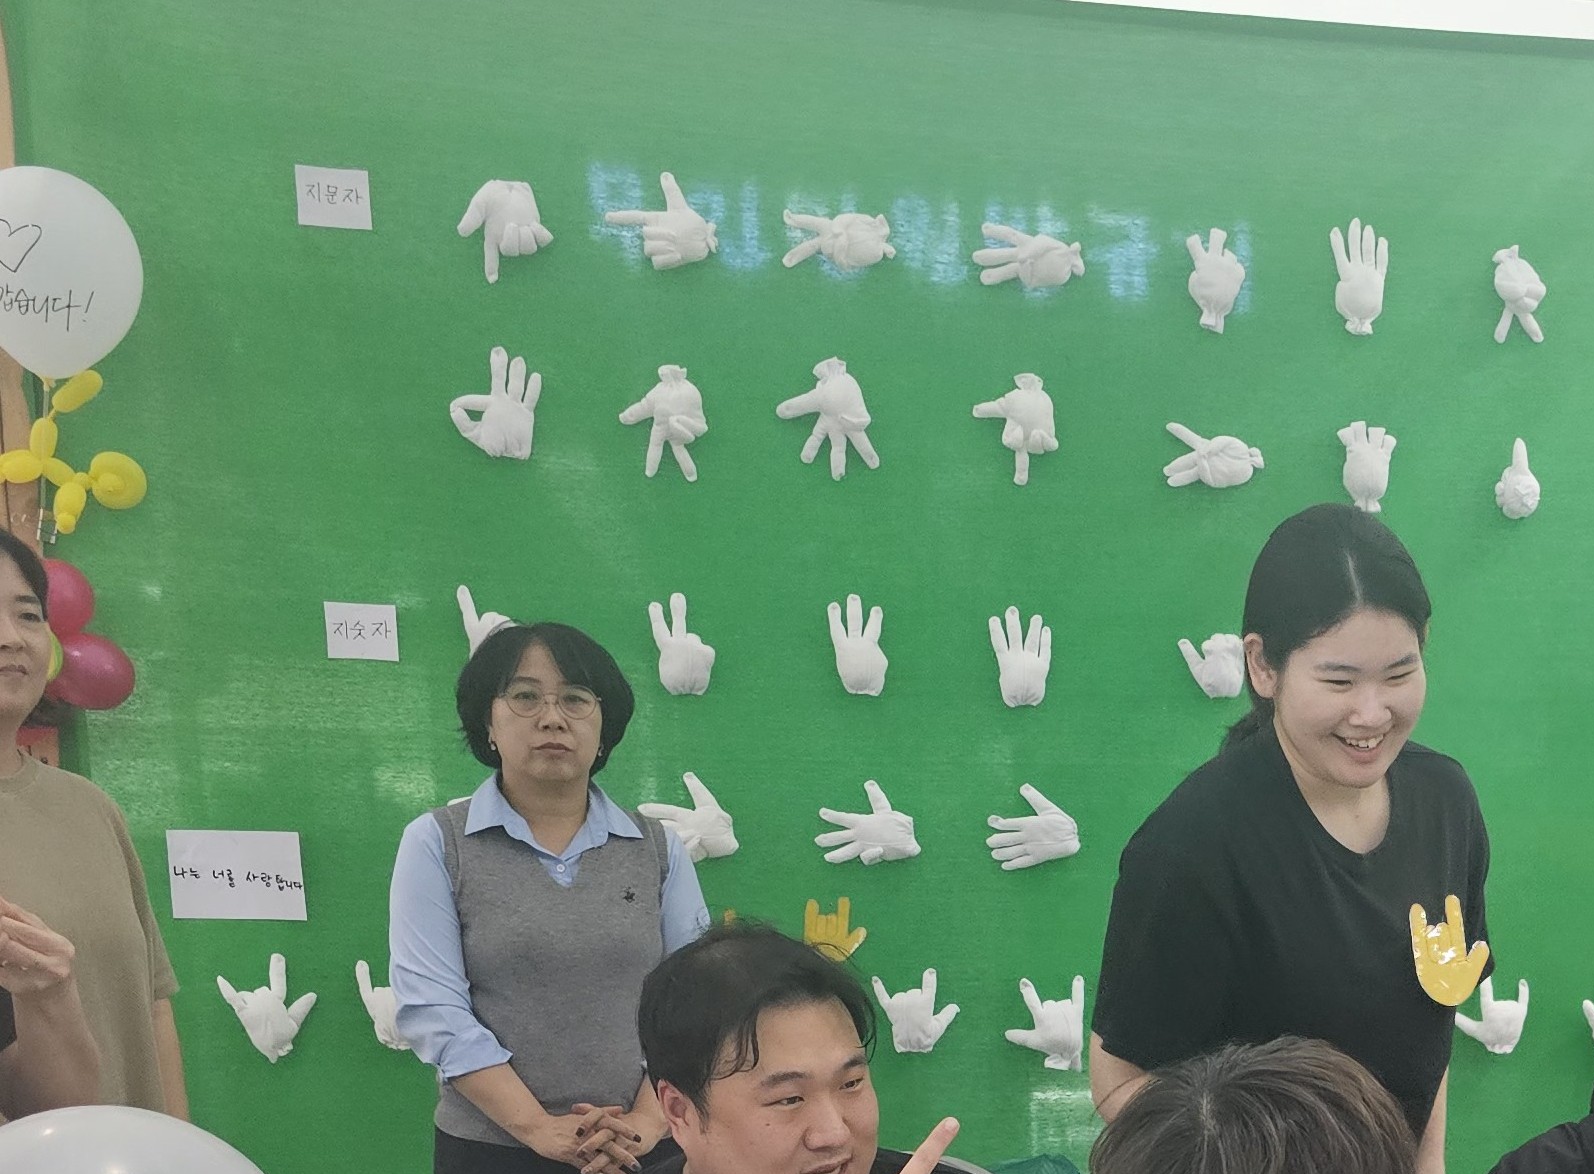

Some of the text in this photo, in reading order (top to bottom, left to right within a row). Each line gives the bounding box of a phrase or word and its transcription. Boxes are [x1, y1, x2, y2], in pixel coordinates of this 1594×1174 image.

[304, 181, 364, 205] 지문자
[332, 619, 392, 640] 지숫자
[173, 865, 200, 880] 나는
[212, 868, 236, 888] 너를
